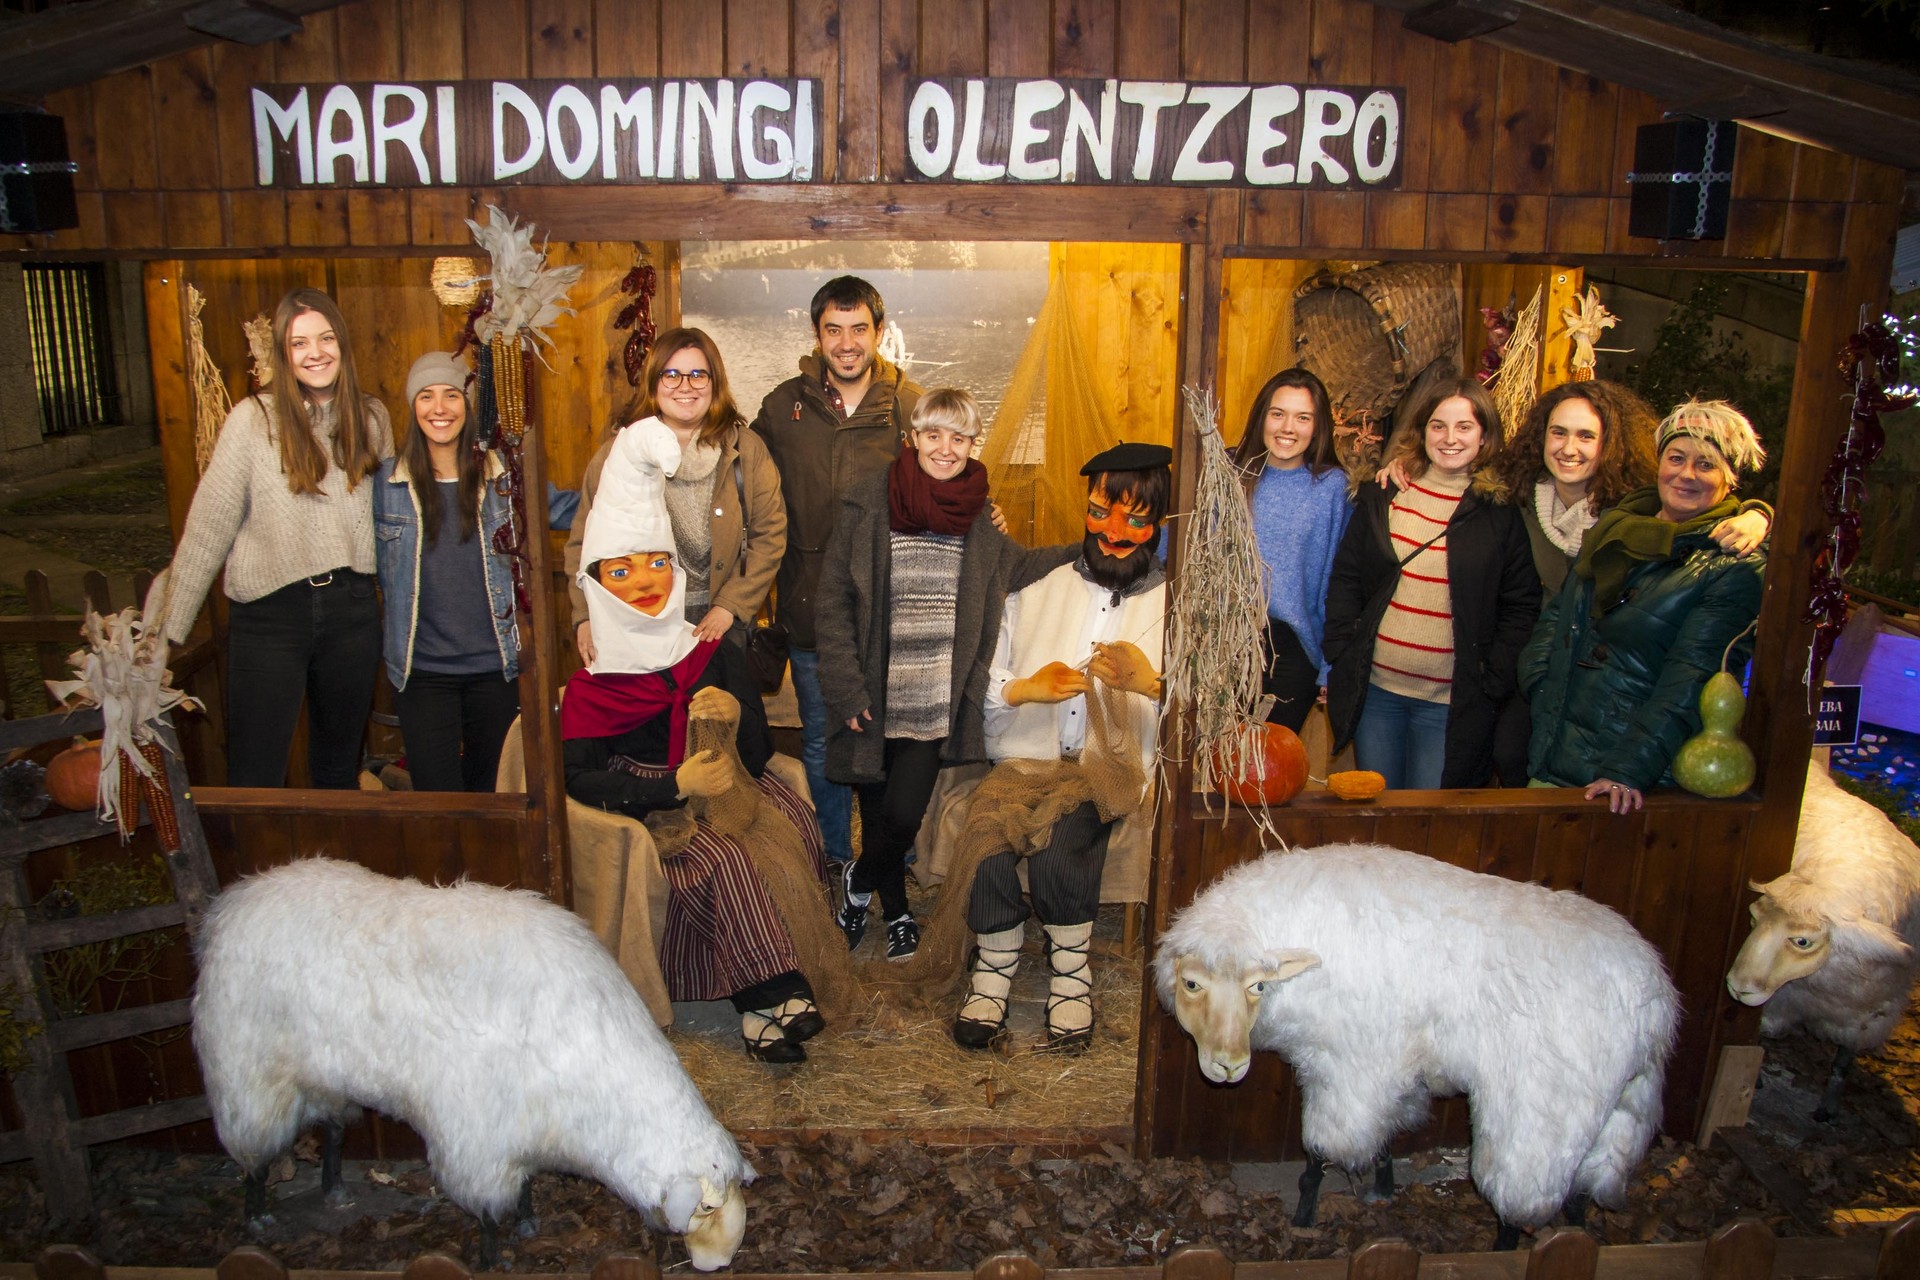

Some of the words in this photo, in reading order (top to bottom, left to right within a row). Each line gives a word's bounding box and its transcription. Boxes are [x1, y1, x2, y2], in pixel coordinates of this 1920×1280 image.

[251, 84, 457, 185] MARI
[492, 79, 814, 182] DOMINGI
[908, 78, 1399, 185] OLENTZERO
